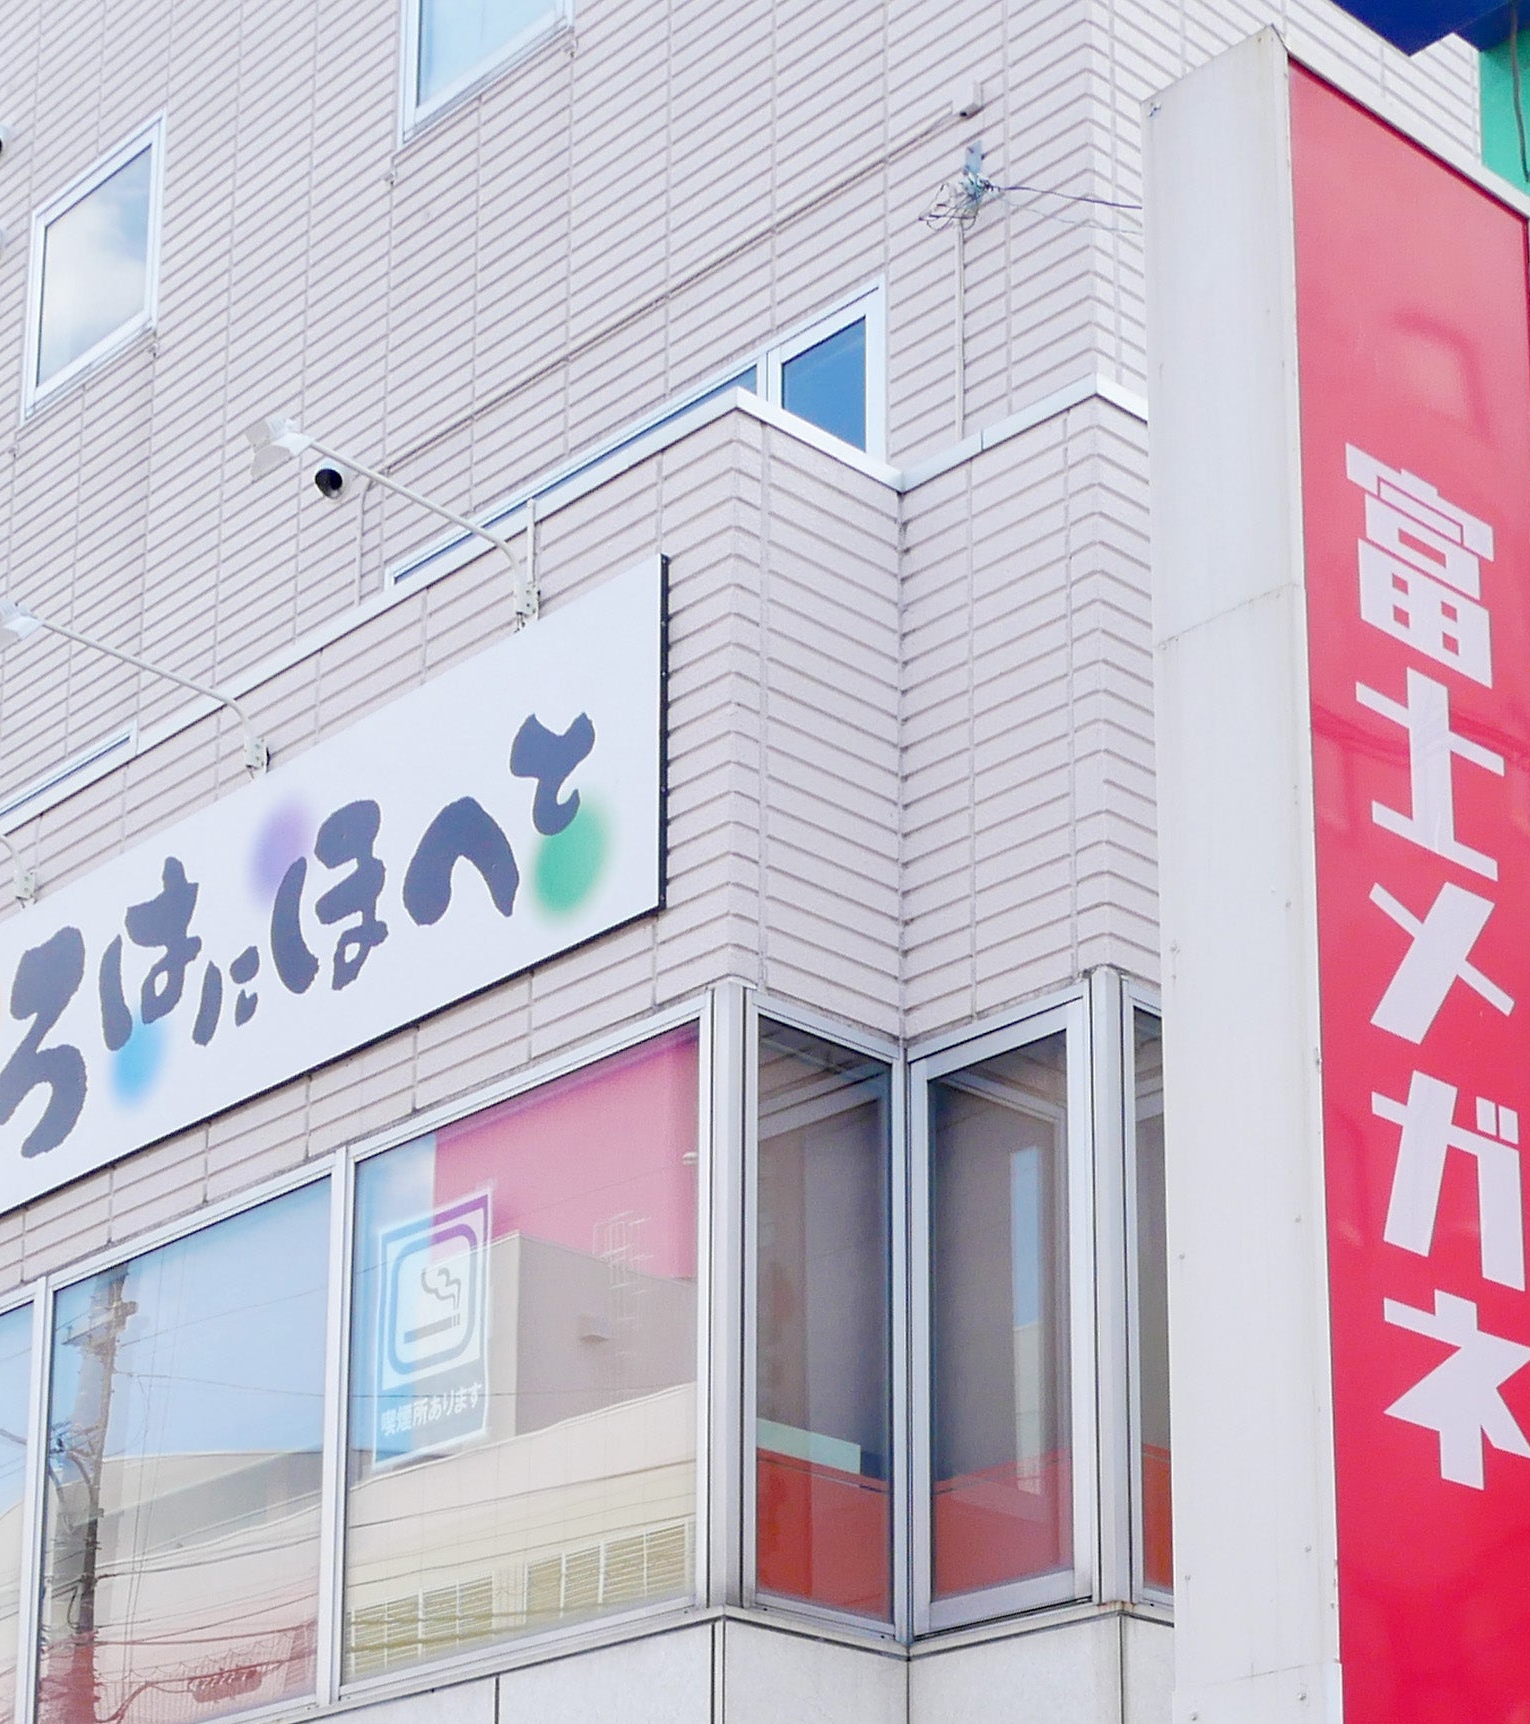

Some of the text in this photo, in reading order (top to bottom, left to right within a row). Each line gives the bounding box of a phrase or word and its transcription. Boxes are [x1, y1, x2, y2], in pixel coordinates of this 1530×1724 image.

[381, 1382, 483, 1437] 喫煙所あります
